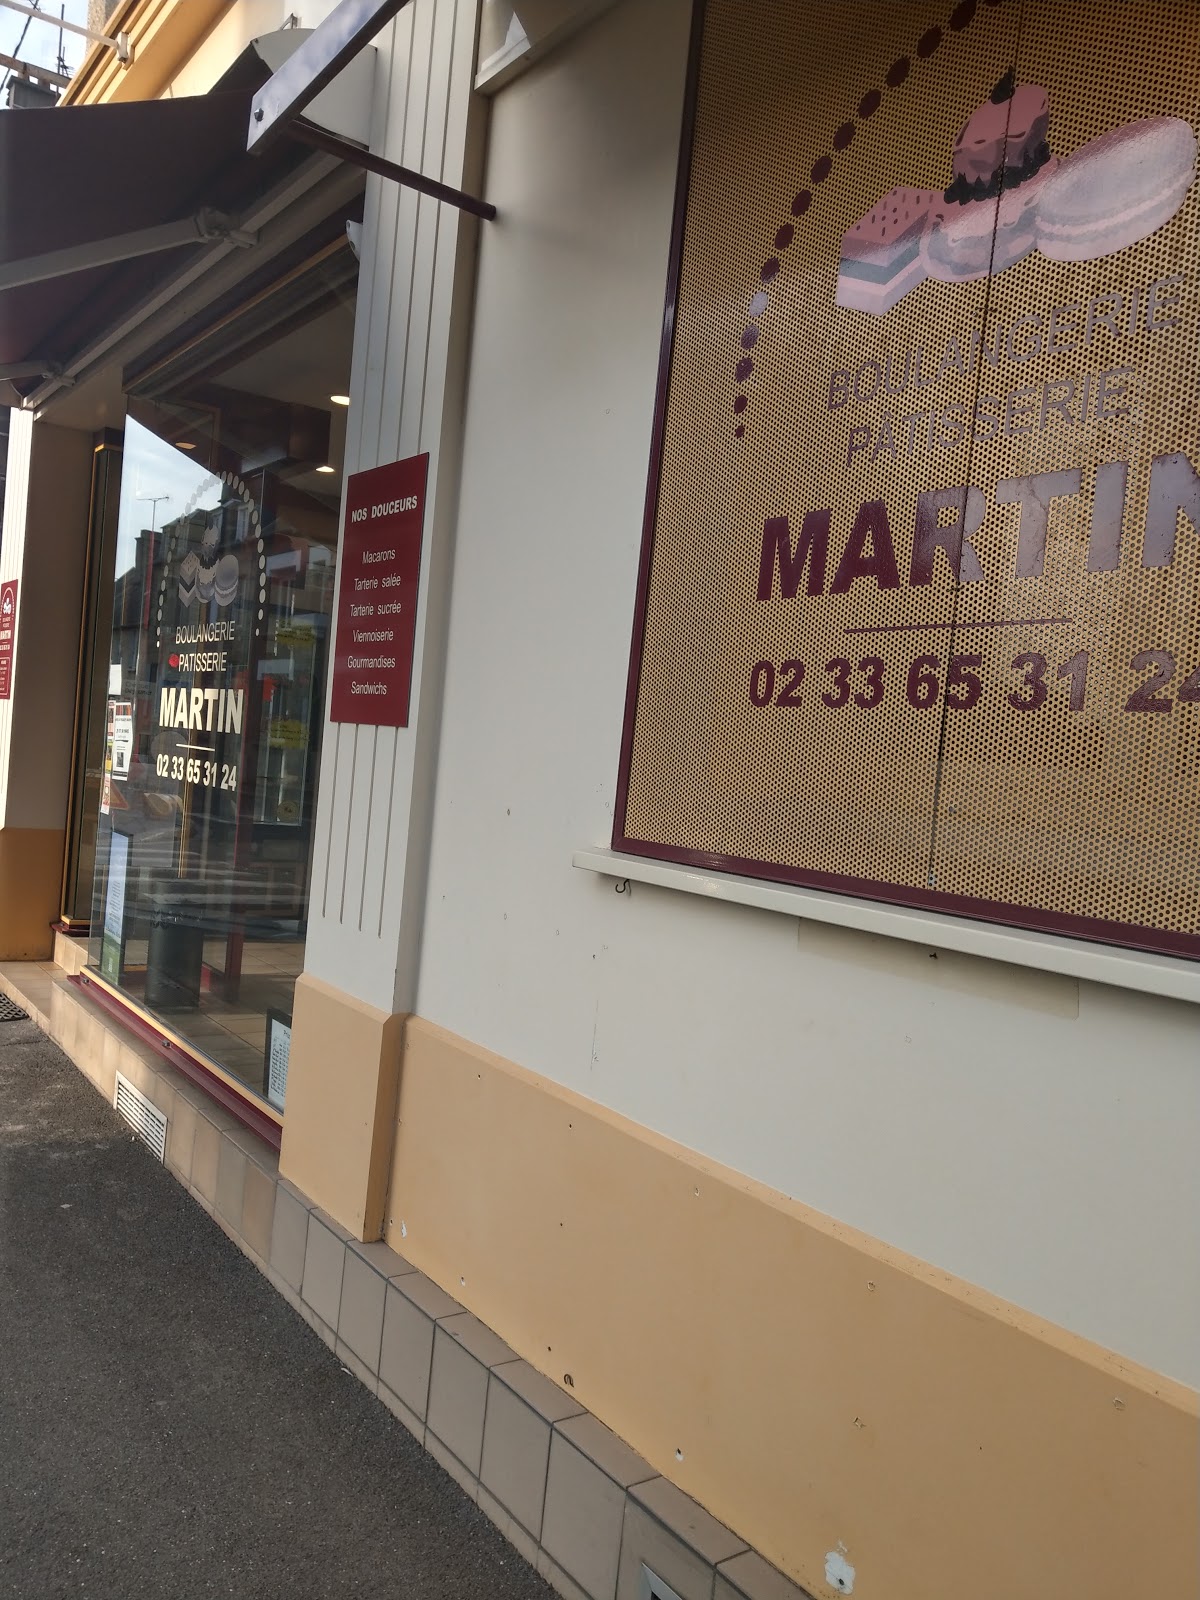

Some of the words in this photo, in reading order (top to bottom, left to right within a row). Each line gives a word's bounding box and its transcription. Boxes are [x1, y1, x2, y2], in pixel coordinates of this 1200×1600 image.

[828, 274, 1186, 410] BOULANGERIE
[847, 366, 1136, 467] PÂTISSERIE
[351, 508, 368, 523] NOS
[371, 495, 418, 519] DOUCEURS
[362, 548, 396, 564] Macarons
[354, 577, 378, 591] Tarterie
[381, 573, 401, 588] salée
[350, 603, 374, 617] Tarterie
[377, 600, 402, 615] sucrée
[175, 620, 236, 644] BOULANGERIE
[352, 628, 394, 643] Viennoiserie
[347, 655, 396, 669] Gourmandises
[350, 681, 388, 696] Sandwichs
[749, 659, 805, 708] 02
[822, 657, 886, 709] 33
[907, 654, 983, 710] 65
[1010, 650, 1091, 712] 31
[159, 687, 244, 734] MARTIN
[156, 754, 169, 777] 02
[171, 756, 184, 781] 33
[186, 758, 201, 784] 65
[203, 761, 217, 788] 31
[220, 764, 237, 791] 24
